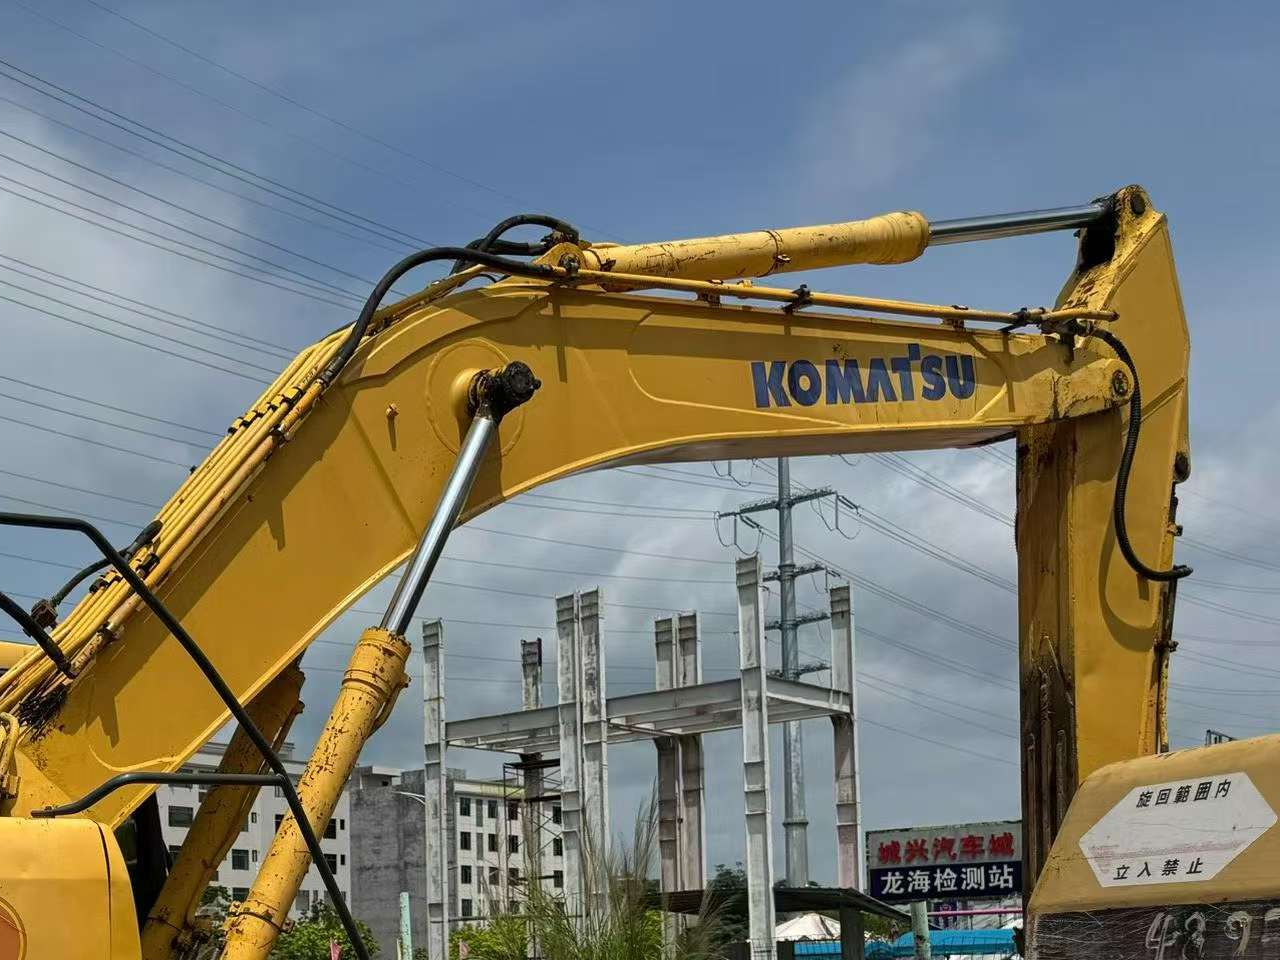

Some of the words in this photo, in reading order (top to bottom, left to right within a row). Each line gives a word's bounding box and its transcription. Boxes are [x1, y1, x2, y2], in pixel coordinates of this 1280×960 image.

[751, 343, 976, 408] KOMATSU
[1135, 778, 1232, 809] 旋回範囲内
[880, 865, 1014, 895] 龙海检测站
[1113, 857, 1204, 881] 立入禁止
